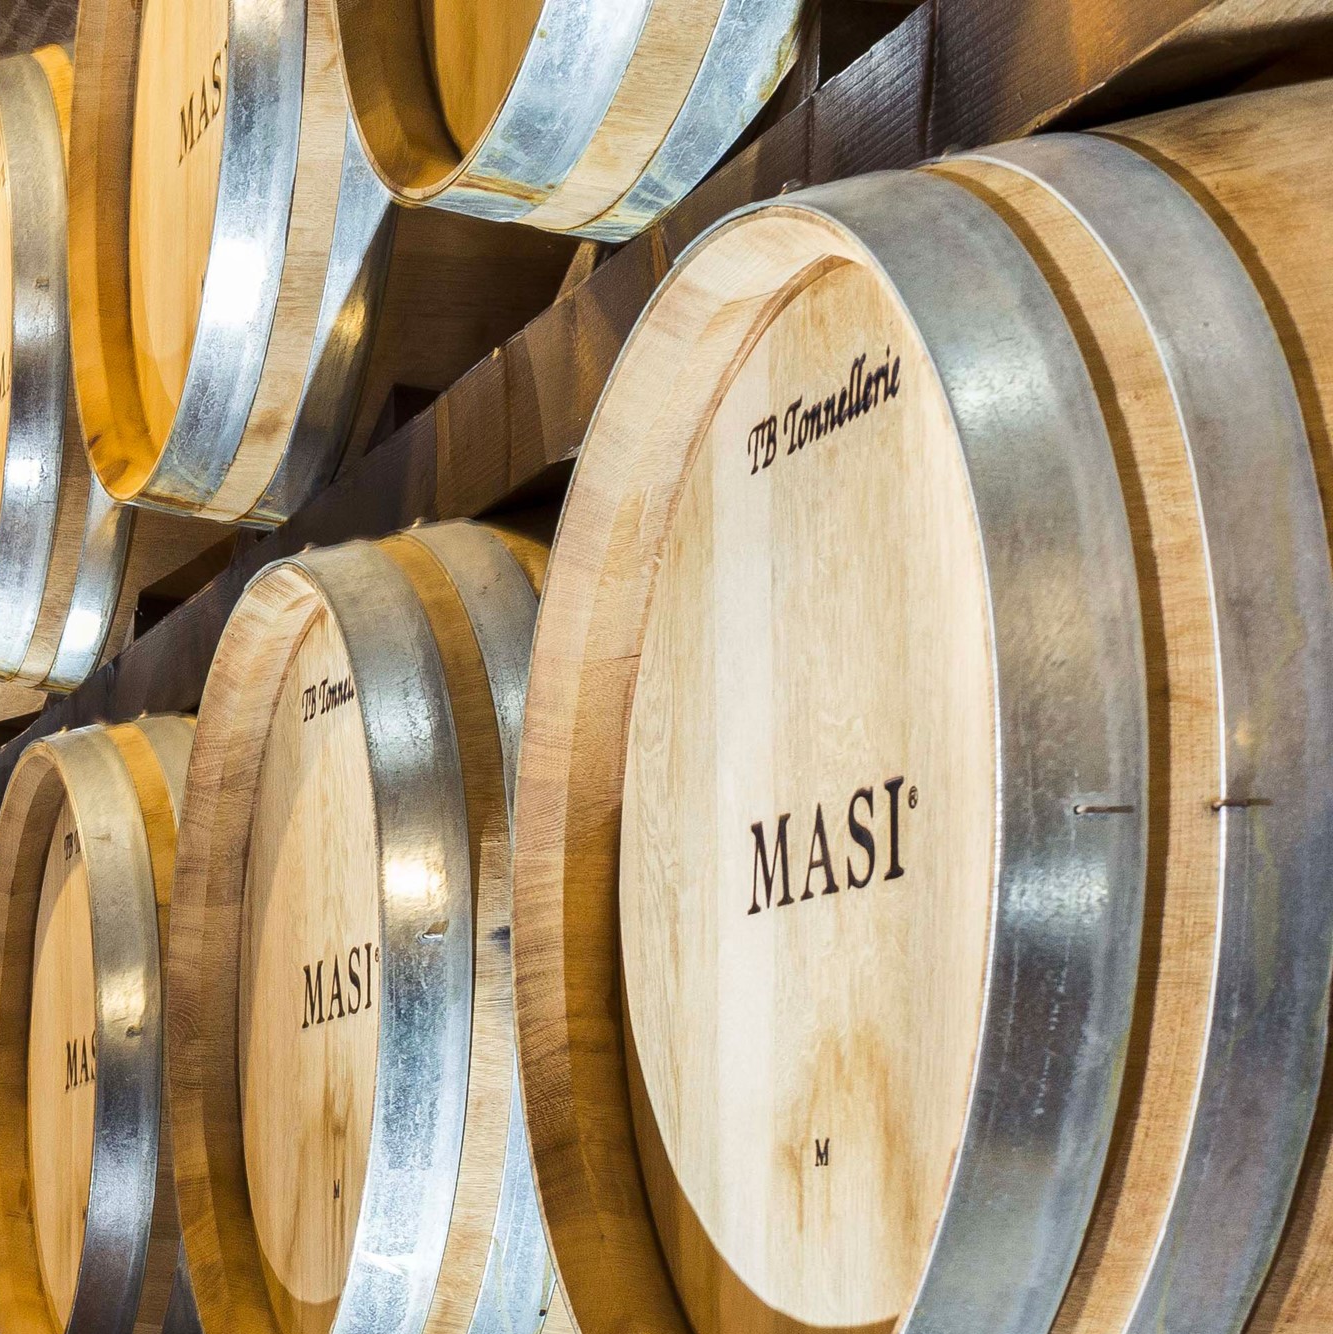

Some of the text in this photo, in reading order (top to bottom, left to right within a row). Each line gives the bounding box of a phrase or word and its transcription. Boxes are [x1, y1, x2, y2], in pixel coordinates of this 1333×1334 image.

[748, 344, 901, 475] TB Tonnellerie
[302, 685, 317, 722] TB
[815, 1138, 830, 1167] M
